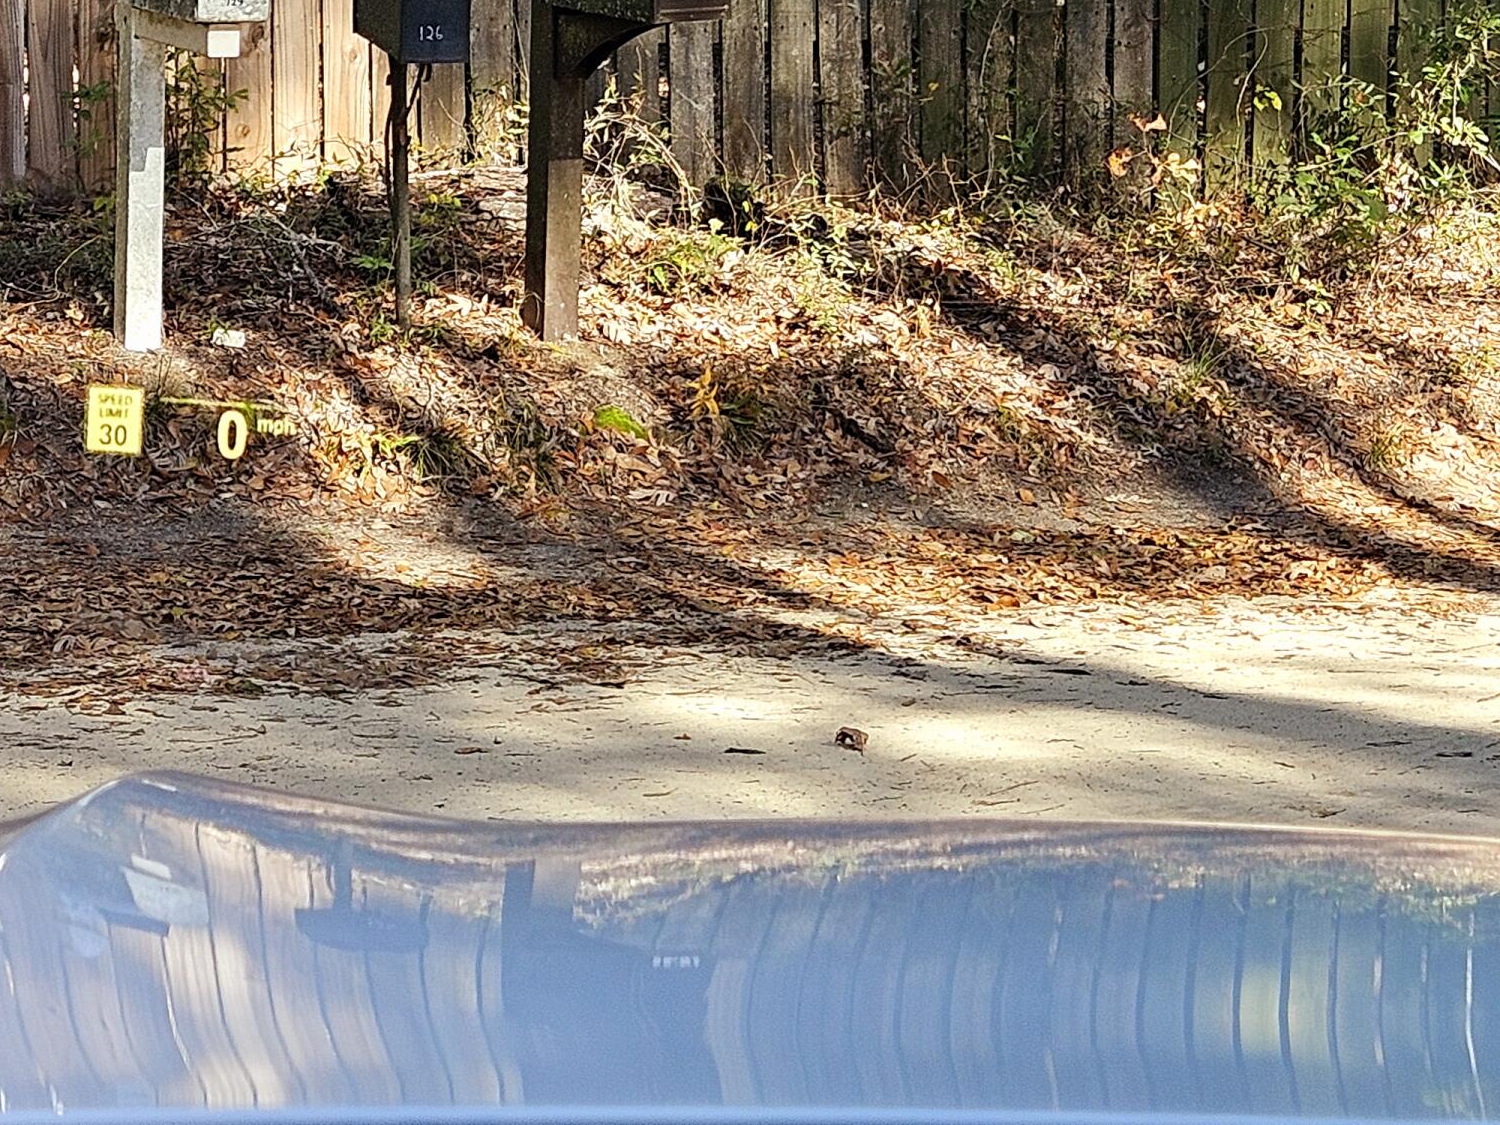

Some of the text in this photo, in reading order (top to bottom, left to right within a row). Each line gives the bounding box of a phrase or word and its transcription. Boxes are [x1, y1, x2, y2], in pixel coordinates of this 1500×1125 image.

[419, 25, 444, 41] 126
[99, 423, 127, 446] 30
[217, 410, 299, 460] 0 mph
